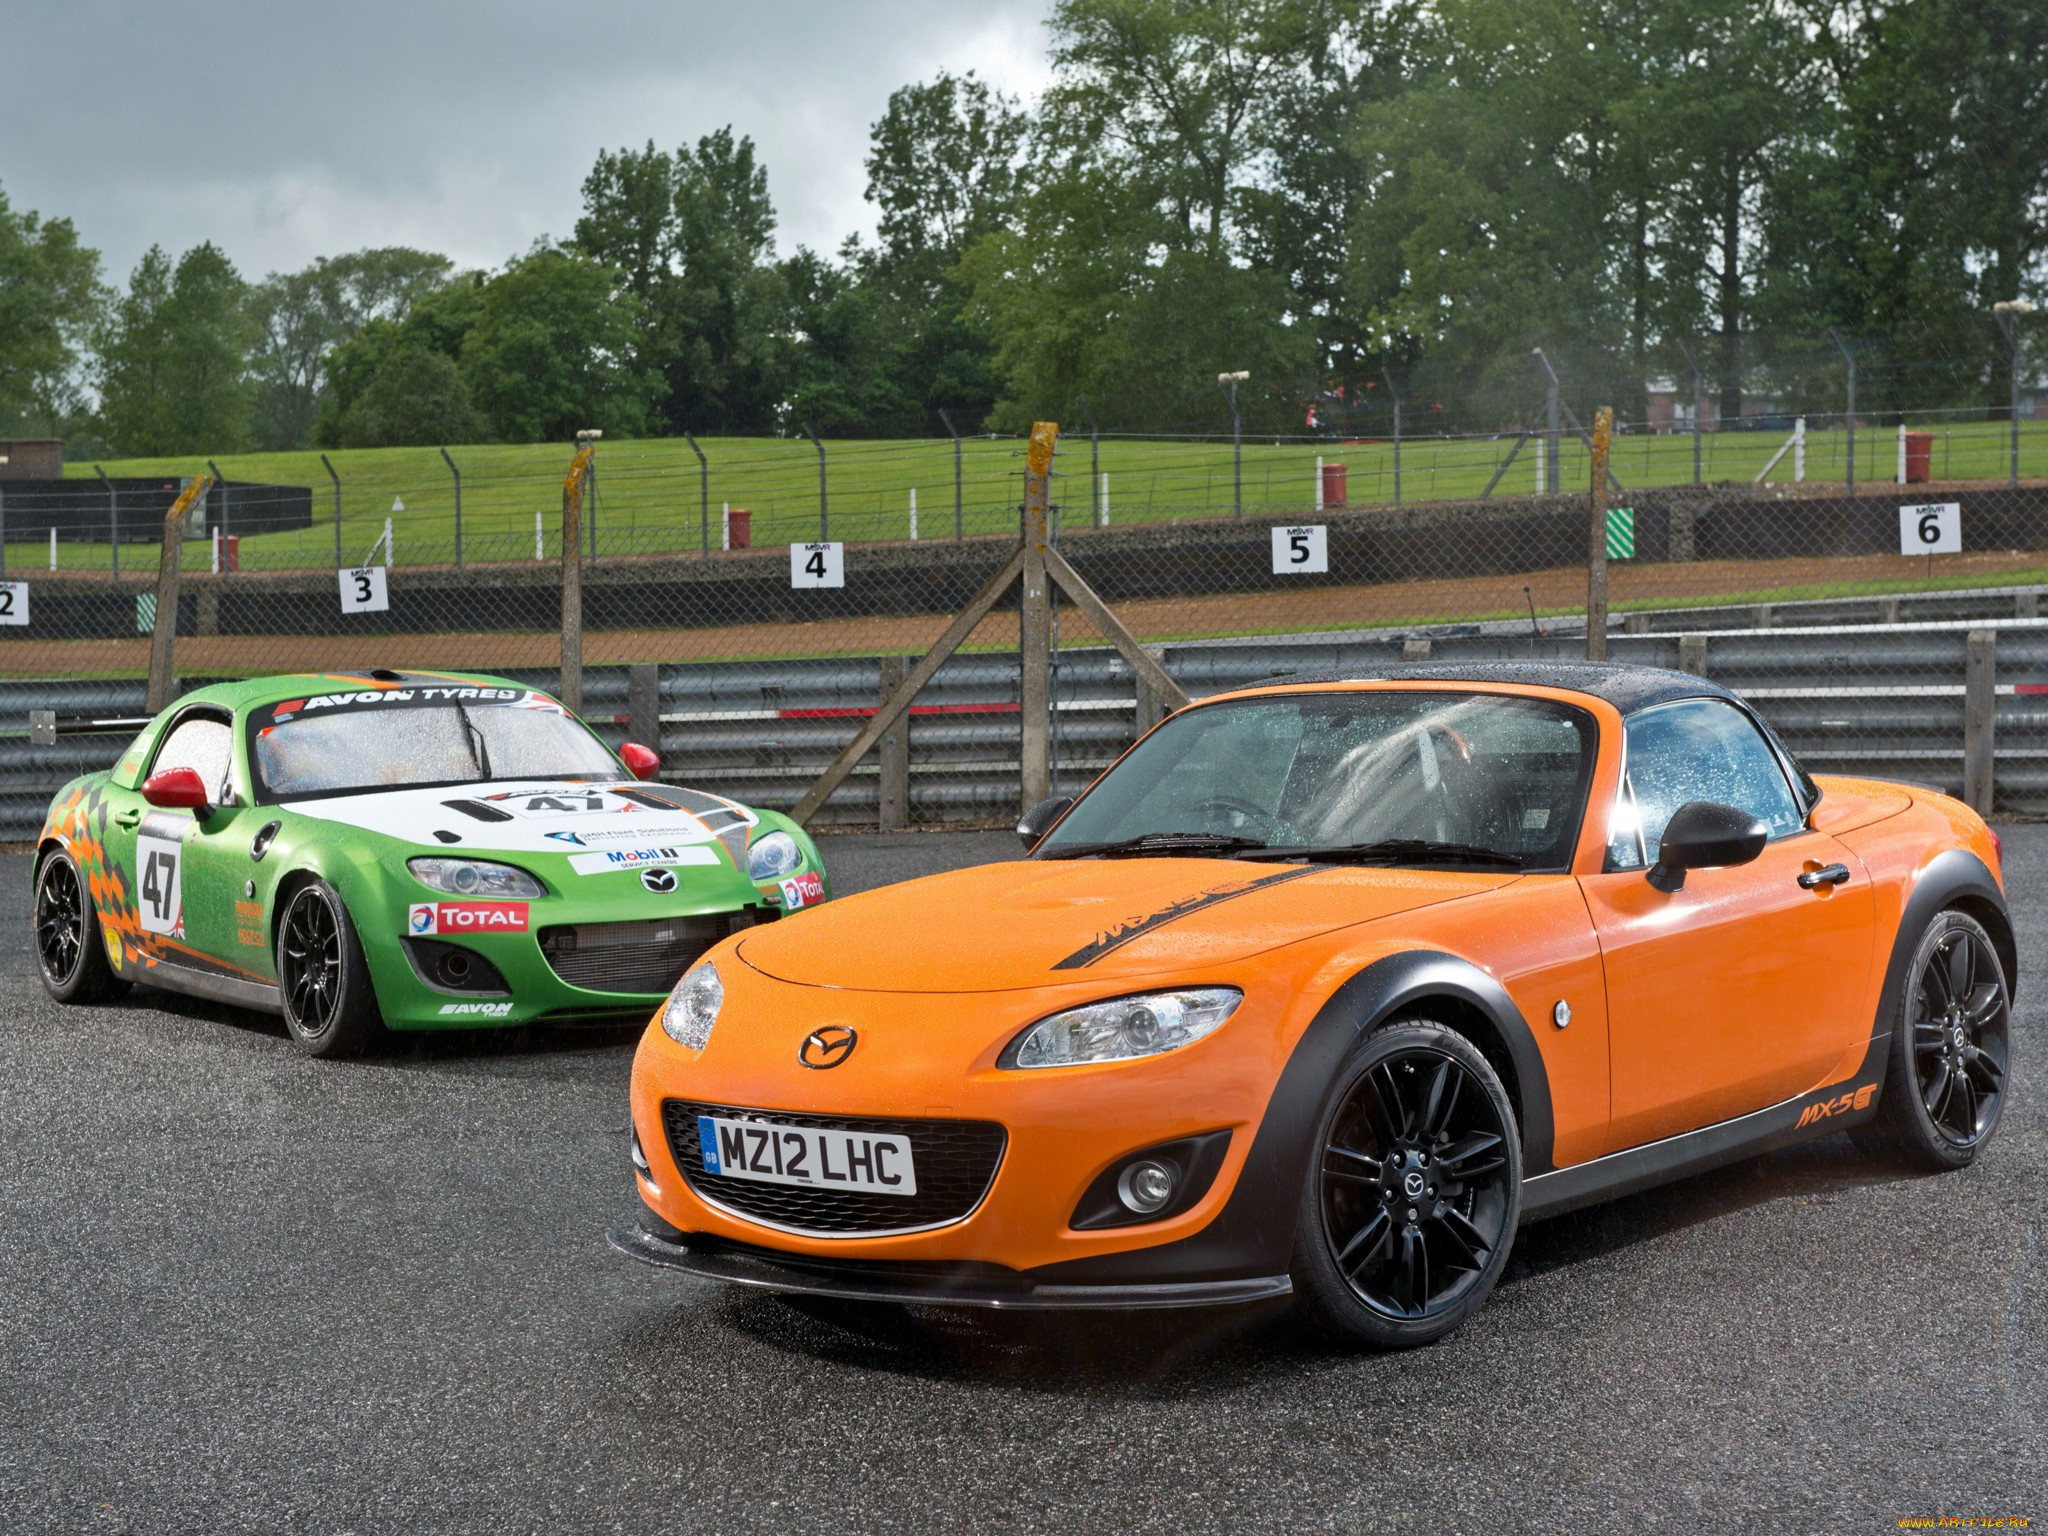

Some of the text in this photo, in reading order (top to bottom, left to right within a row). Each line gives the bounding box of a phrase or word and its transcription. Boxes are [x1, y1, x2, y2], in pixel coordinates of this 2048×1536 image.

[1918, 514, 1941, 544] 6
[1291, 536, 1310, 563] 5
[805, 552, 827, 578] 4
[355, 576, 372, 603] 3
[0, 591, 14, 616] 2
[304, 688, 516, 710] AVON TYRES
[607, 848, 679, 862] Mobil 1
[621, 861, 649, 869] SERVICE
[142, 850, 176, 921] 47
[441, 908, 525, 926] TOTAL
[454, 1002, 515, 1014] AVON
[1794, 1092, 1855, 1130] MX-5
[705, 1151, 718, 1164] GB
[719, 1125, 903, 1186] MZ12 LHC
